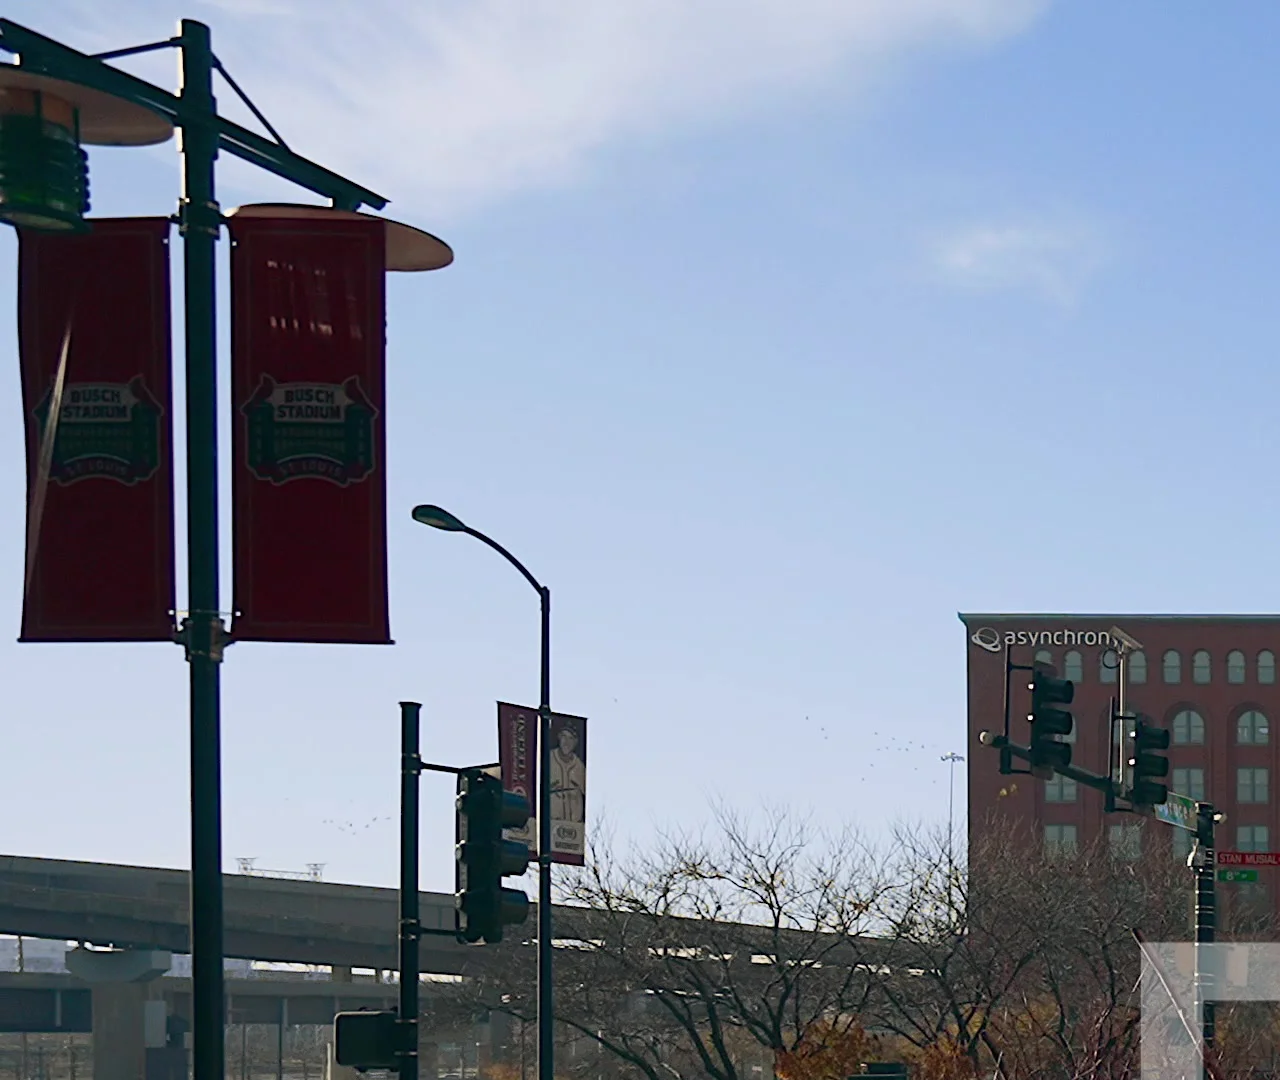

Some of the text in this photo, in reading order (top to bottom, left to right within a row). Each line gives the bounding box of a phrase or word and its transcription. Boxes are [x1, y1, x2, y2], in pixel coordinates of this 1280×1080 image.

[71, 388, 121, 404] BUSCH
[283, 388, 335, 404] BUSCH
[62, 405, 131, 420] STADIUM
[276, 405, 341, 420] STADIUM
[518, 713, 526, 769] LEGEND
[1219, 853, 1242, 864] STAN
[1245, 854, 1278, 865] MUSIAL
